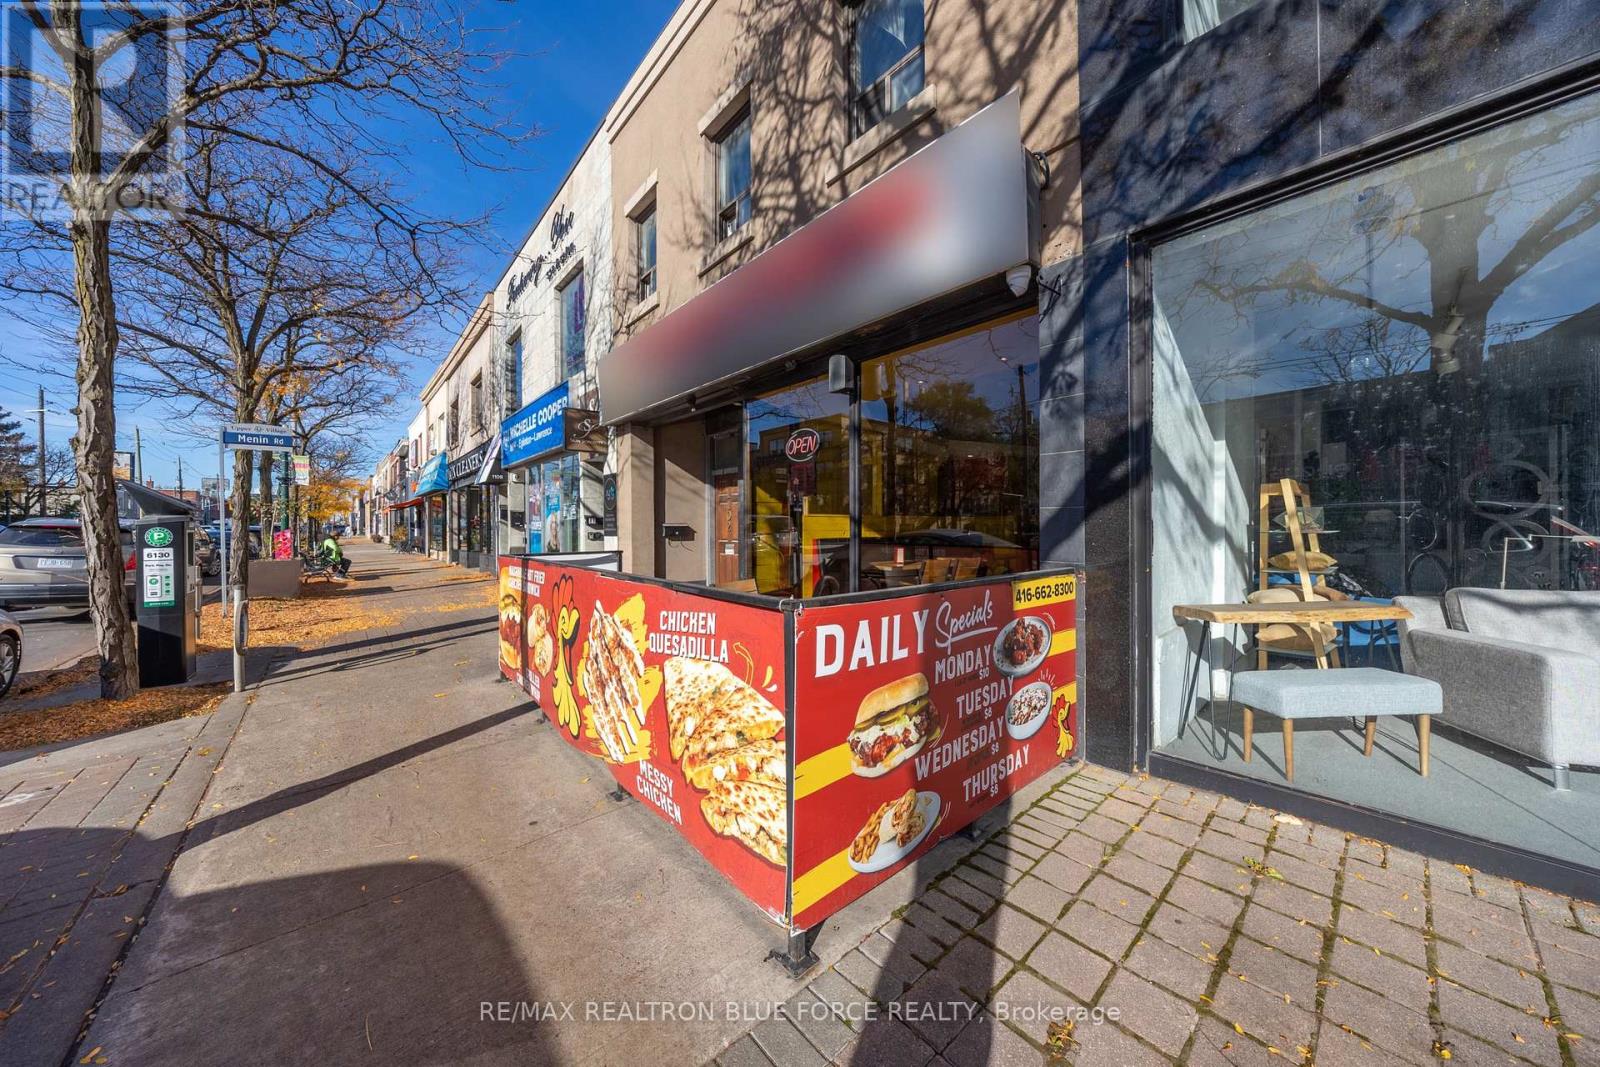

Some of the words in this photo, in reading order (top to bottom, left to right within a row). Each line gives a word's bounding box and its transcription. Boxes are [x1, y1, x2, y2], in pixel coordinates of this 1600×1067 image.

[537, 395, 568, 426] COOPER
[238, 434, 269, 444] Menin
[788, 435, 817, 455] OPEN
[1015, 581, 1074, 604] 416-662-8300
[659, 610, 717, 635] CHICKEN
[815, 608, 930, 679] DAILY
[935, 589, 993, 655] Specials
[648, 632, 730, 664] QUESADILLA
[935, 644, 992, 685] MONDAY
[956, 675, 1014, 719] TUESDAY
[914, 715, 1005, 782] WEDNESDAY
[639, 759, 674, 798] MESSY
[963, 743, 1030, 802] THURSDAY
[636, 774, 683, 826] CHICKEN
